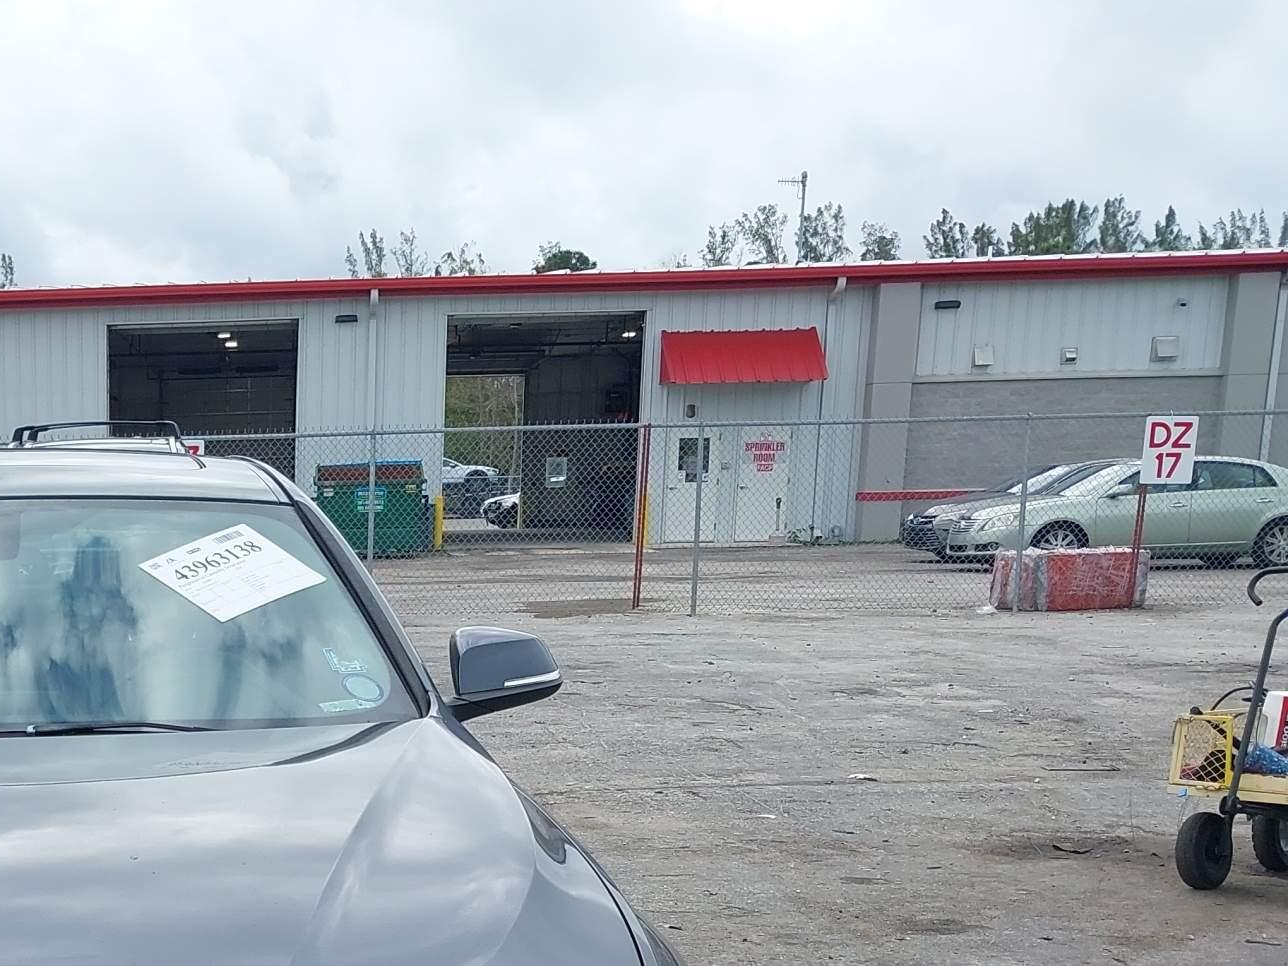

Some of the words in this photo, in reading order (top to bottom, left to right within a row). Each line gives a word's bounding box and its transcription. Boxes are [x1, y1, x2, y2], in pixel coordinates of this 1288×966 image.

[745, 442, 785, 452] SPRINKLER
[1149, 422, 1194, 448] DZ
[753, 453, 776, 462] ROOM
[1155, 453, 1182, 478] 17
[174, 540, 262, 581] 43963138
